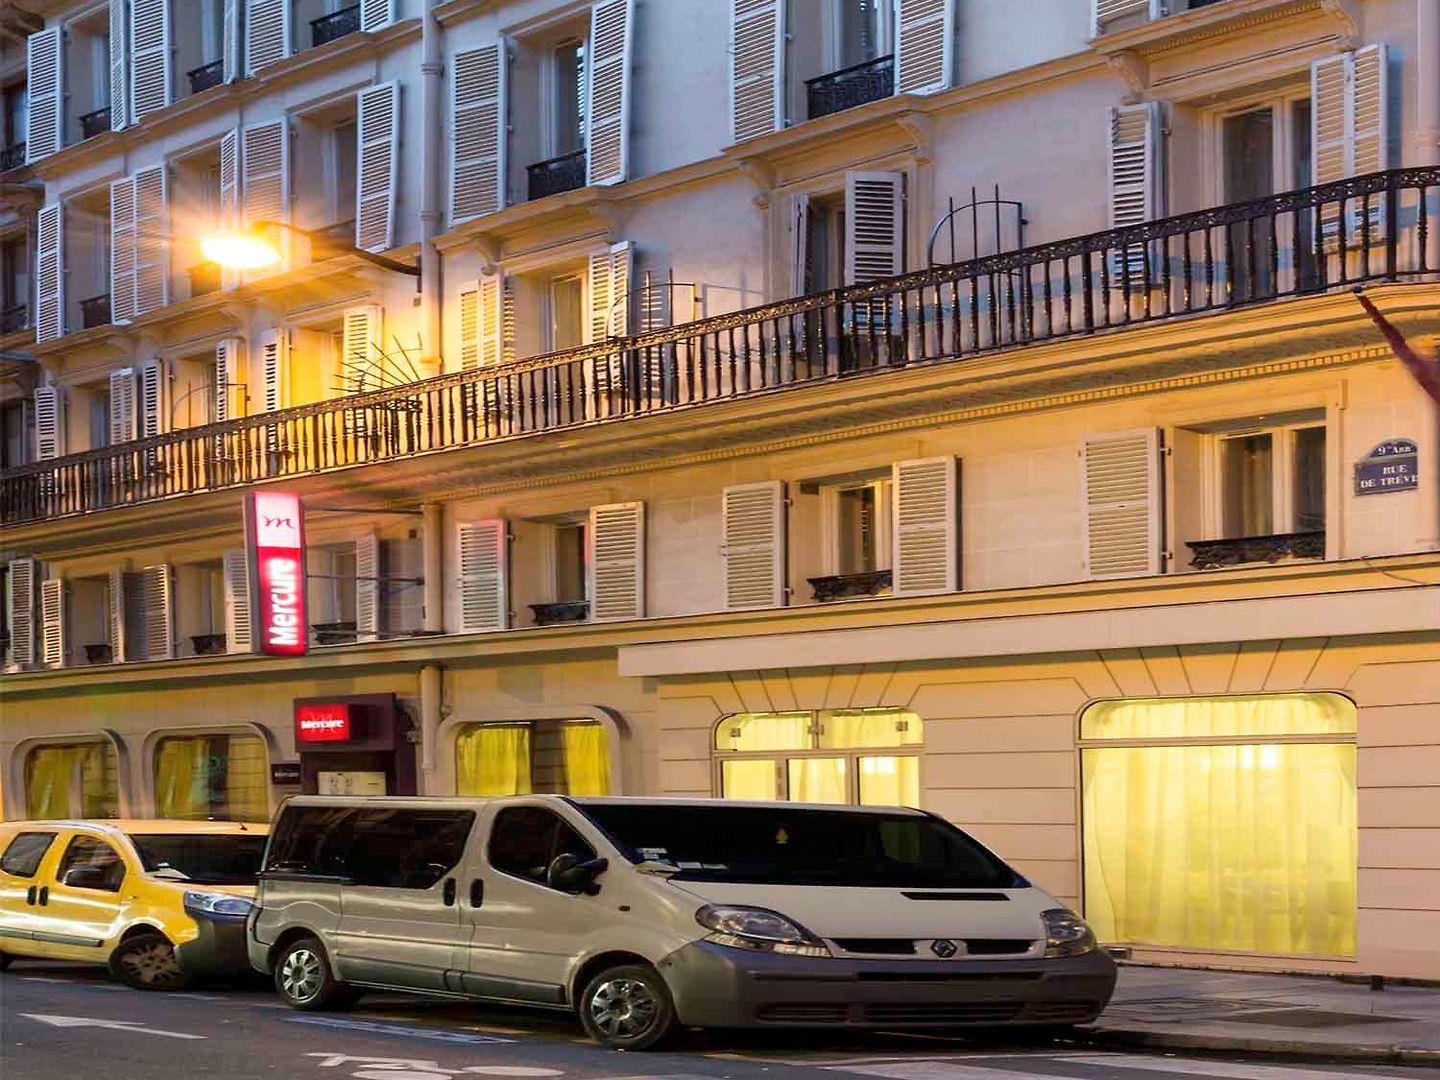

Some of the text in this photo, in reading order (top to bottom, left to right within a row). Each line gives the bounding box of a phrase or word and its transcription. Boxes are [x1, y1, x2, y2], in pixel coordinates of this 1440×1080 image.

[1383, 464, 1408, 475] RUE
[1361, 479, 1376, 488] DE
[269, 556, 299, 646] Mercure
[300, 719, 345, 730] Mercure
